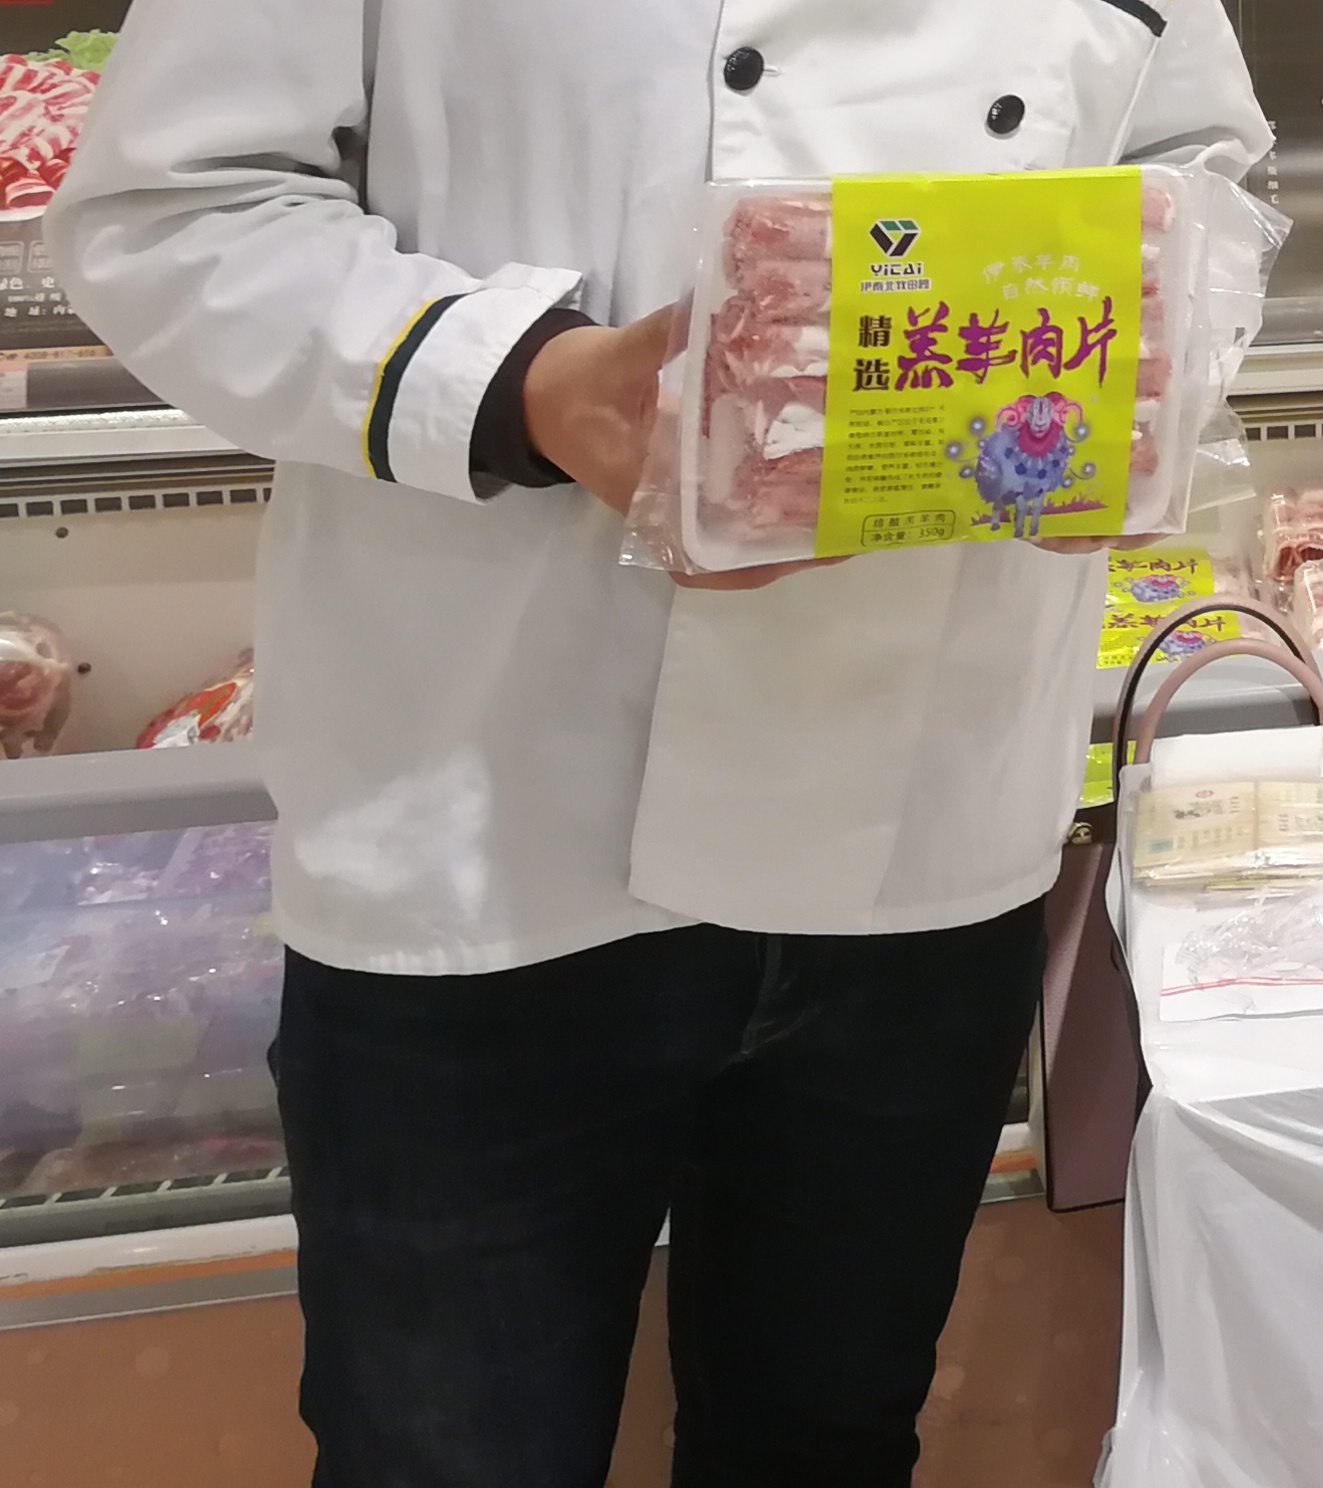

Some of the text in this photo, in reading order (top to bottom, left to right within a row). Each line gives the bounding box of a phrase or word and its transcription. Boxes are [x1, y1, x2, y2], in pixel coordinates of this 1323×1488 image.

[852, 314, 892, 392] 精选
[895, 295, 1118, 392] 羔羊肉片
